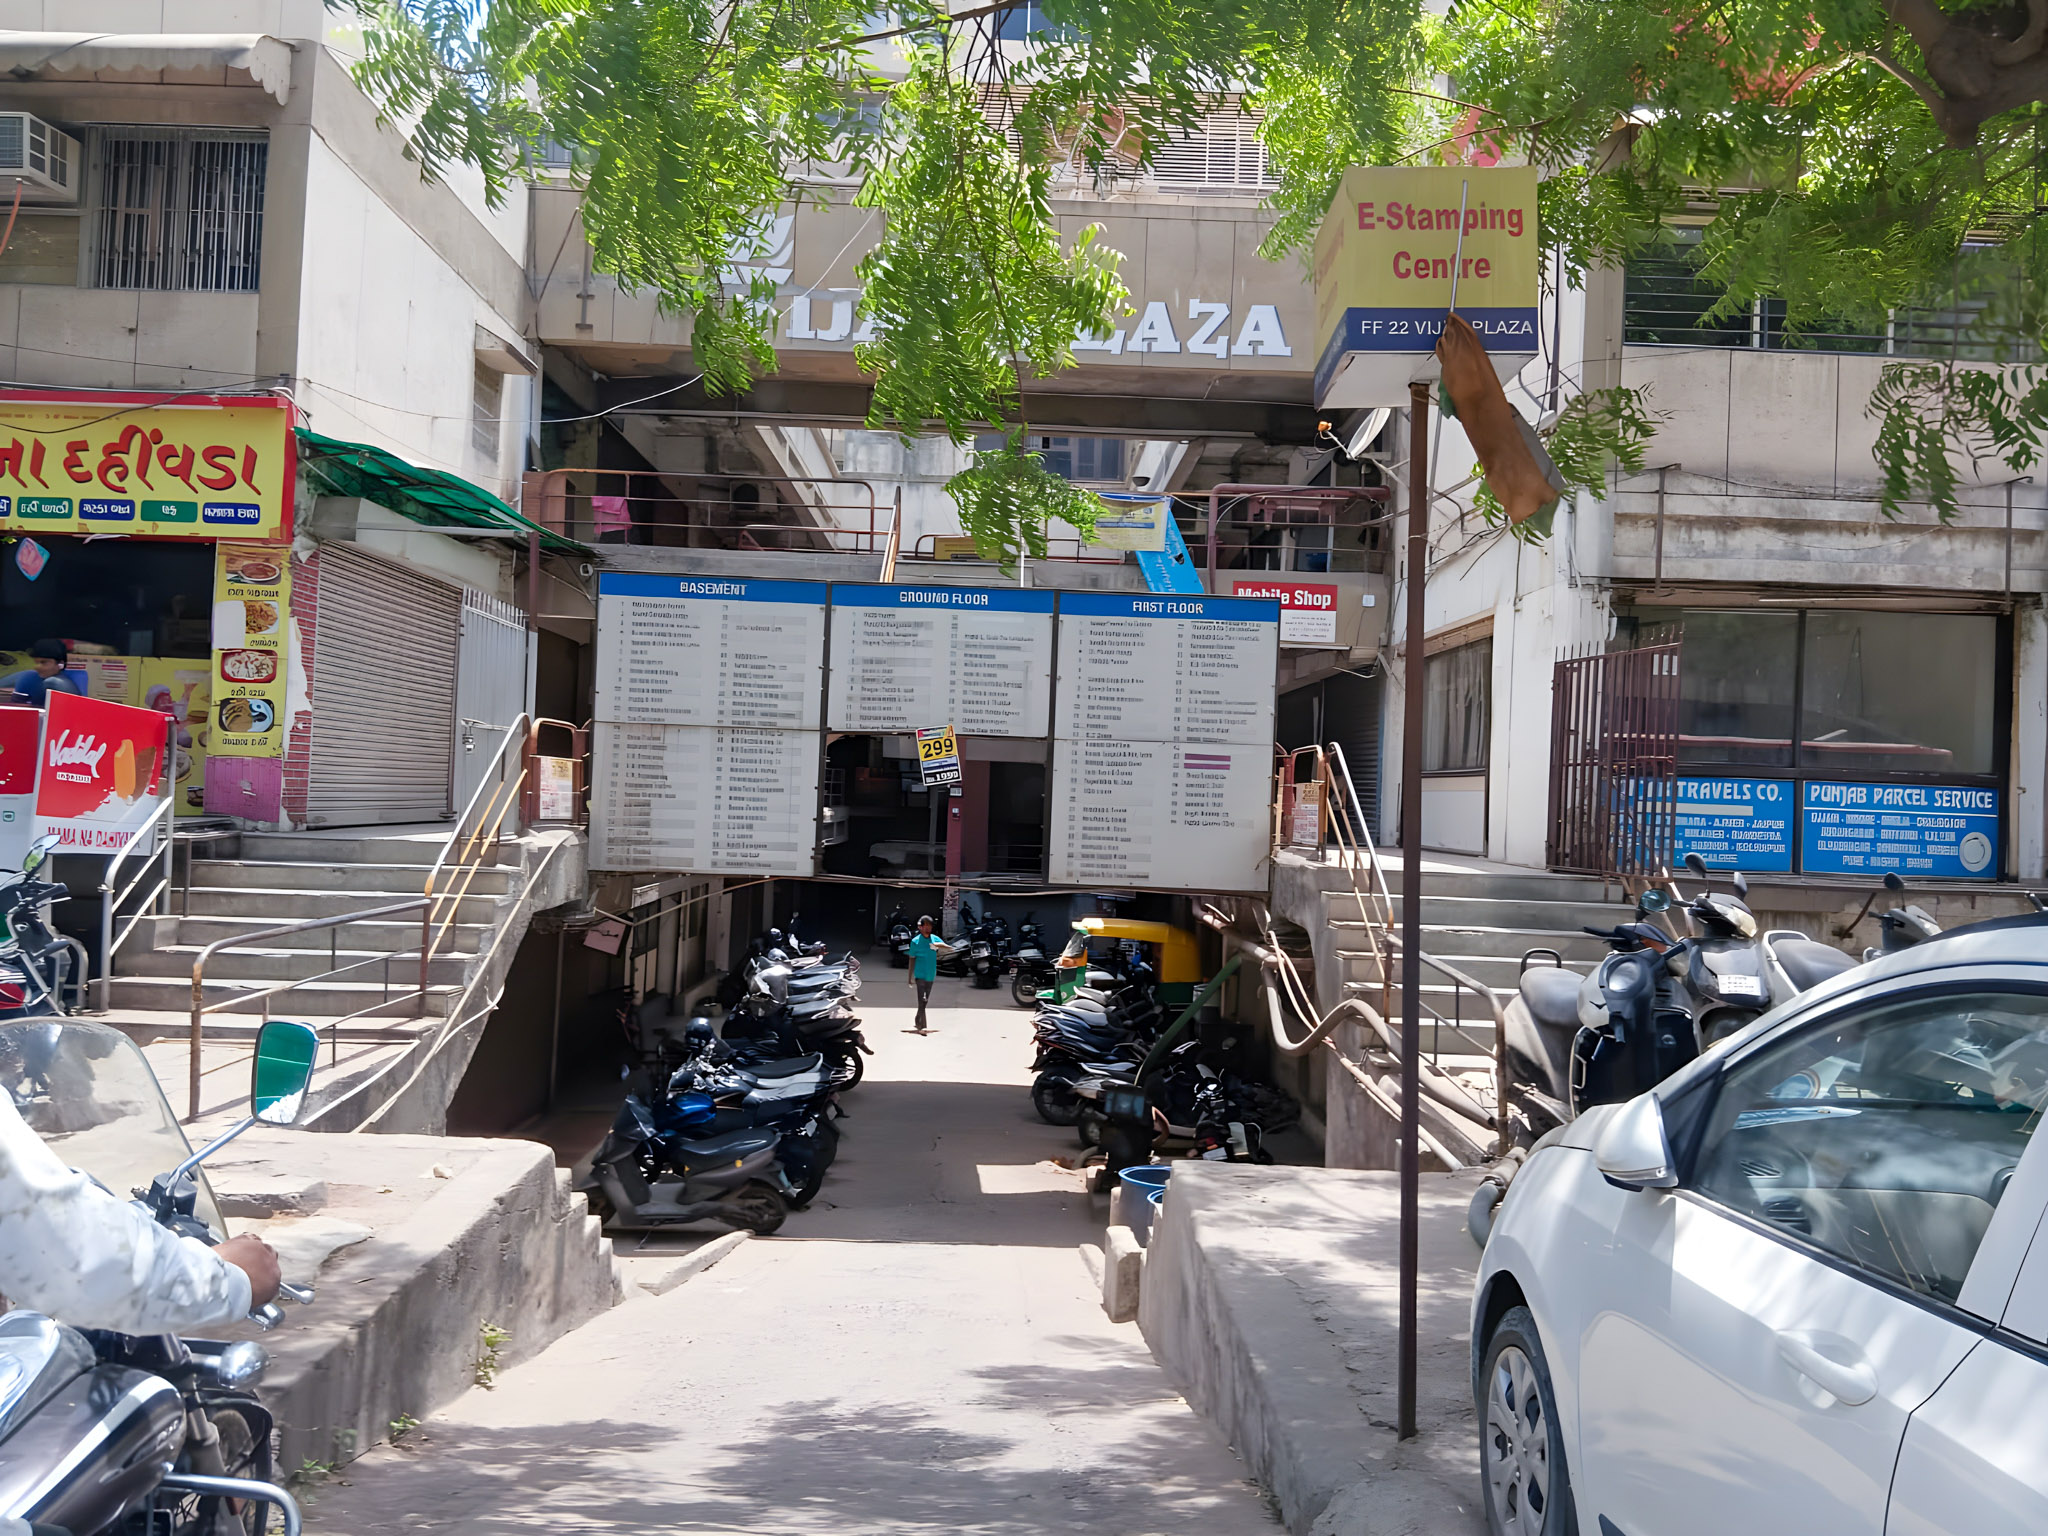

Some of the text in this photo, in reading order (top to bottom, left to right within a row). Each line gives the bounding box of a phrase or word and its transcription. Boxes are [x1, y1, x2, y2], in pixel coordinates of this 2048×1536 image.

[1357, 201, 1524, 237] E-Stamping
[1393, 251, 1492, 279] Centre
[1066, 298, 1293, 359] LAZA
[1361, 320, 1383, 335] FF
[1388, 320, 1409, 335] 22
[1414, 320, 1449, 335] VIJ
[680, 581, 748, 596] BASEMENT
[900, 591, 988, 606] GROUND FLOOR
[1132, 601, 1204, 615] FIRST FLOOR
[1294, 590, 1332, 609] Shop
[922, 738, 954, 759] 299
[1676, 781, 1752, 800] TRAVELS
[1756, 783, 1783, 802] CO.
[1873, 787, 1928, 807] PARCEL
[1934, 790, 1993, 809] SERVICE
